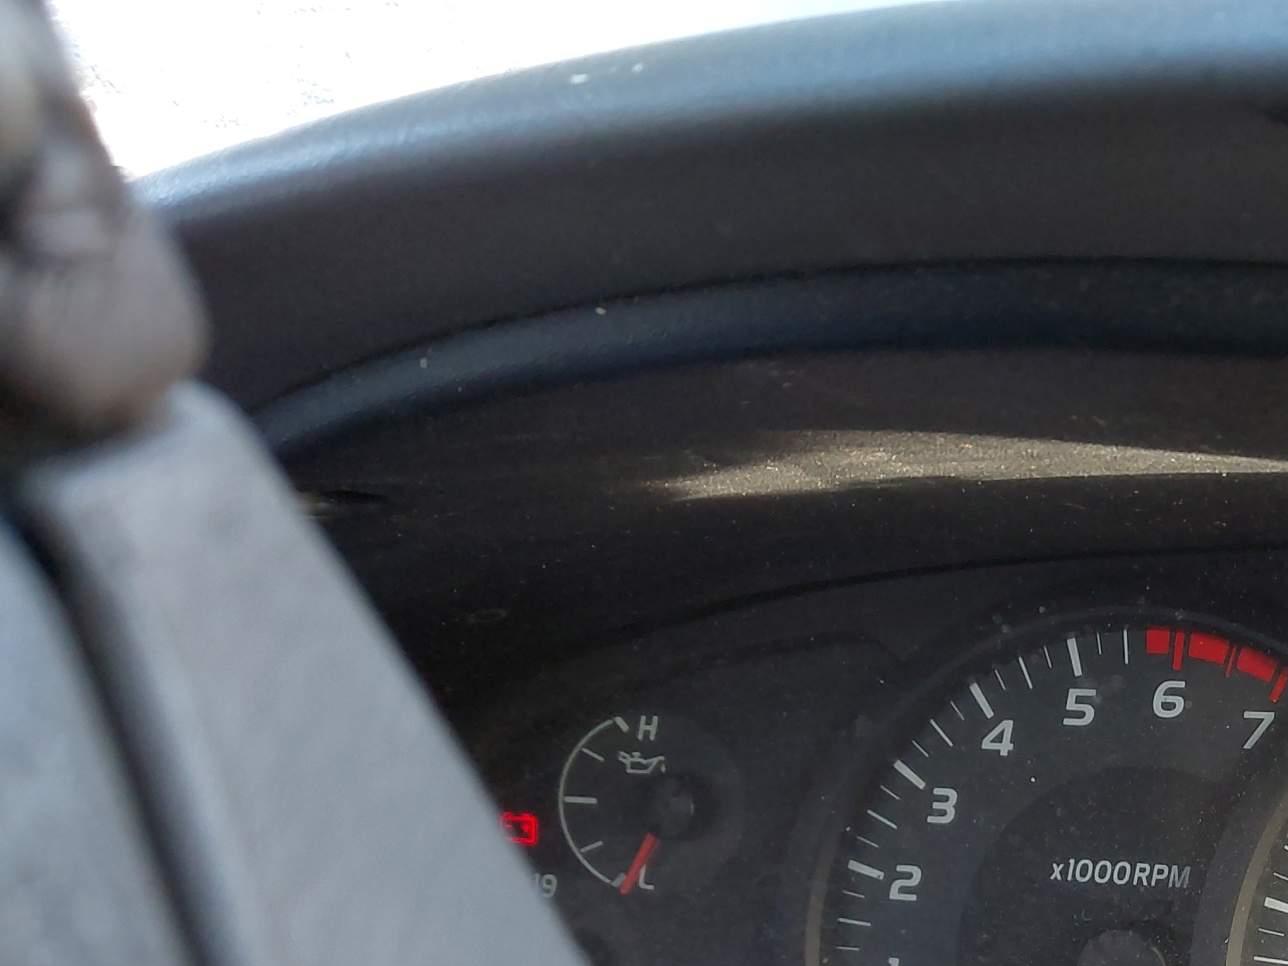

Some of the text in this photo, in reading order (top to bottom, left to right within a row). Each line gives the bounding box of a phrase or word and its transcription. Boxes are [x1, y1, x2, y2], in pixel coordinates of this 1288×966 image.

[1063, 688, 1097, 727] 5
[1152, 680, 1186, 719] 6
[638, 715, 659, 741] H
[981, 719, 1014, 756] 4
[1242, 710, 1275, 750] 7
[926, 787, 958, 824] 3
[889, 864, 922, 901] 2
[1050, 857, 1191, 888] x1000RPM
